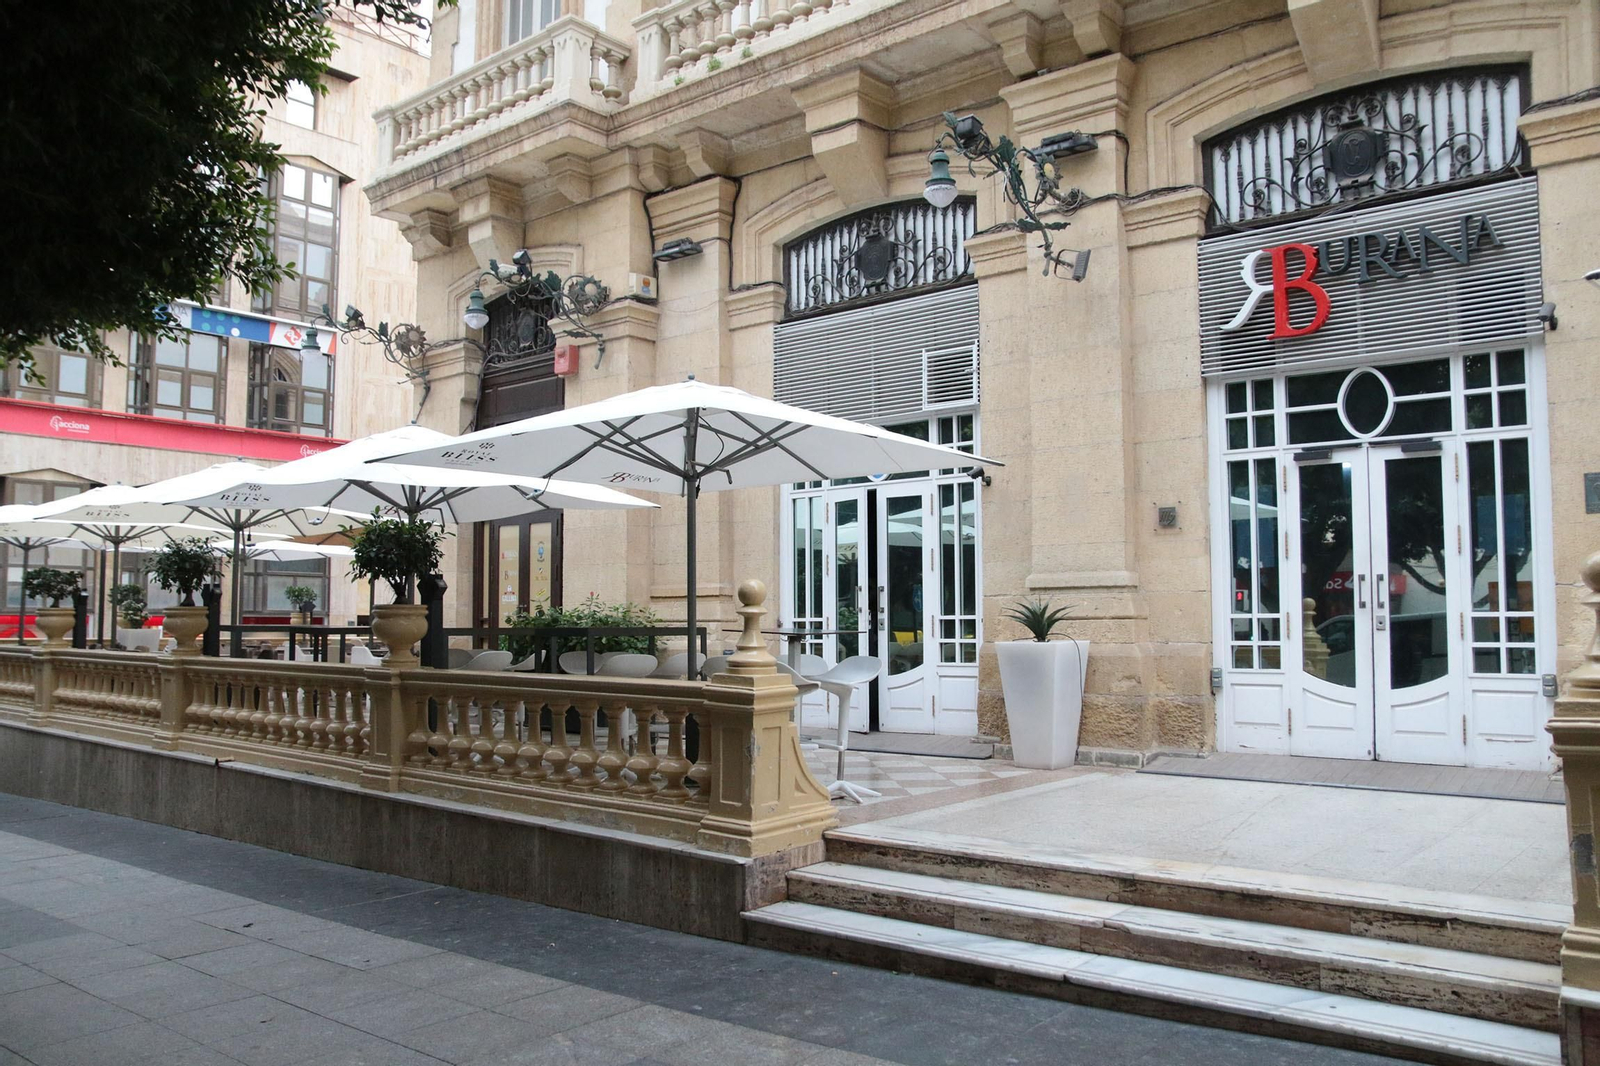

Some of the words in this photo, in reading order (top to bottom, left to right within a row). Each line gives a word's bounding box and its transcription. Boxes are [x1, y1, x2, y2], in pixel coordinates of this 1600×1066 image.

[1266, 213, 1506, 341] BURANA
[59, 421, 90, 431] acciona
[441, 451, 498, 461] BLISS
[219, 494, 271, 502] BLISS
